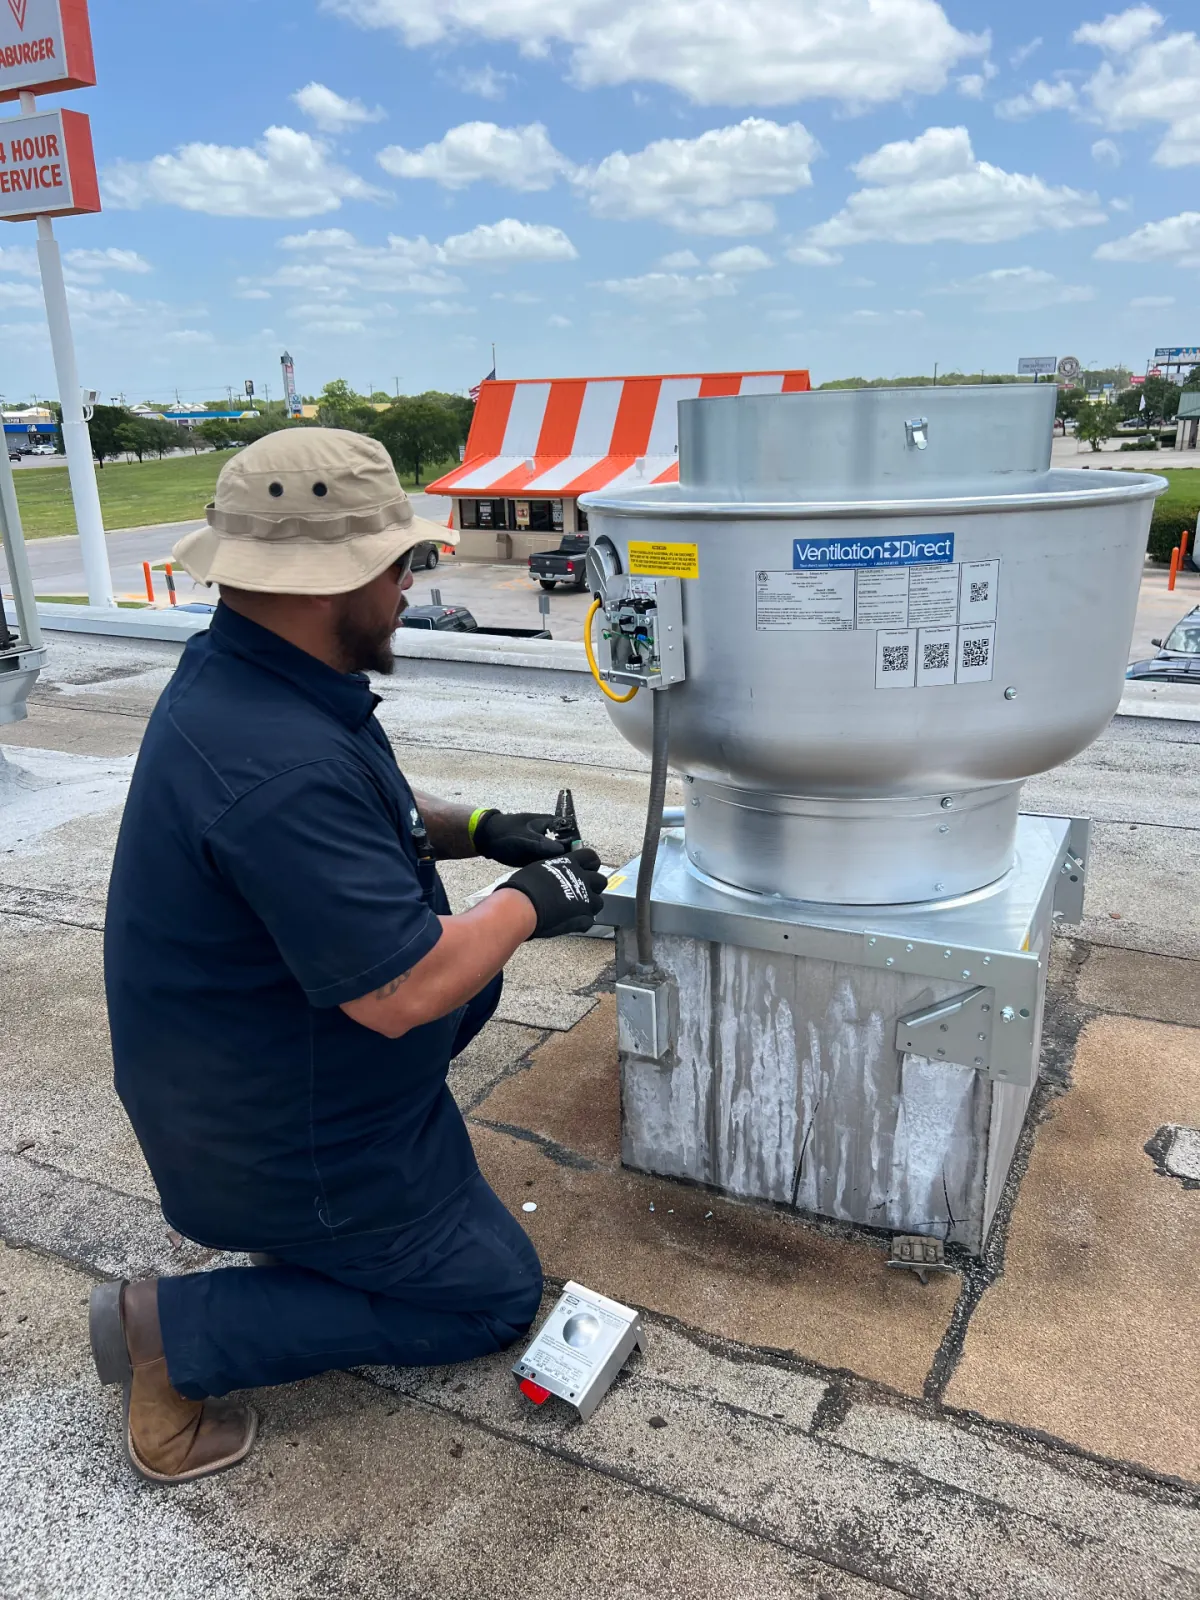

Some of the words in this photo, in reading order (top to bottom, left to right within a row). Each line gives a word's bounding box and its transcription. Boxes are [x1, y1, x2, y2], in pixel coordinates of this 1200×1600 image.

[11, 134, 60, 164] HOUR
[1, 164, 63, 194] ERVICE
[796, 541, 883, 561] Ventilation
[900, 539, 951, 558] Direct
